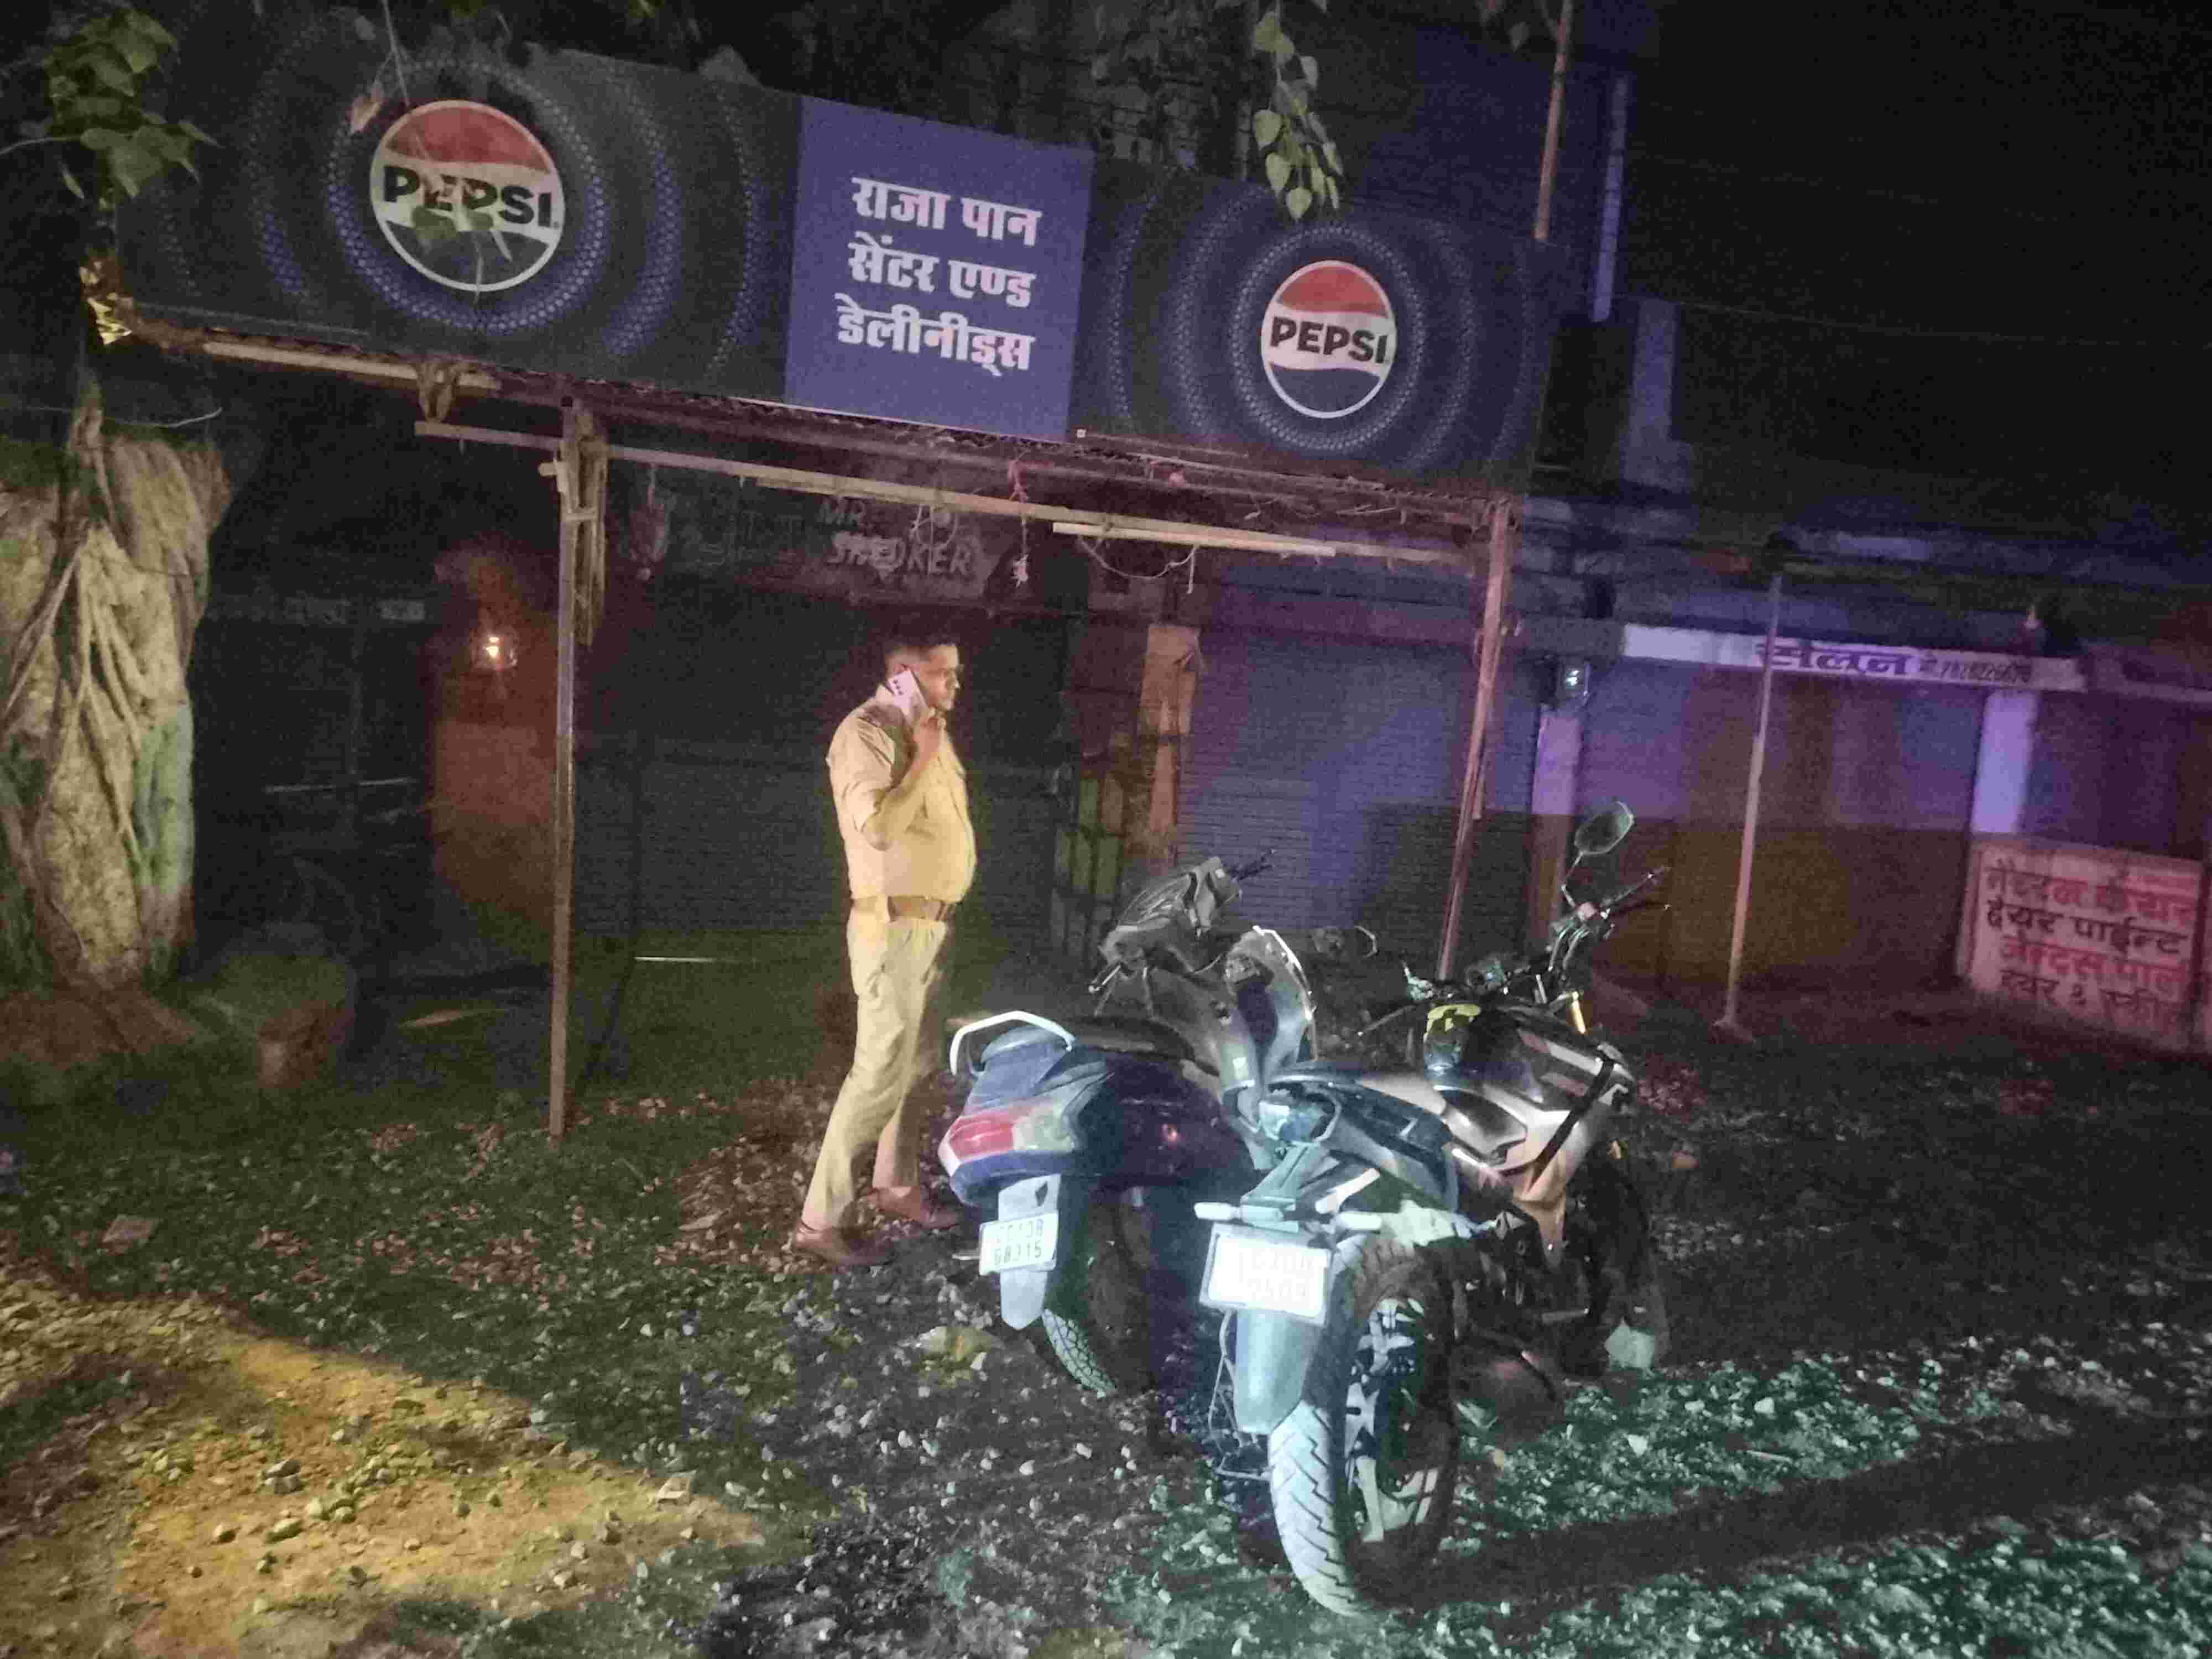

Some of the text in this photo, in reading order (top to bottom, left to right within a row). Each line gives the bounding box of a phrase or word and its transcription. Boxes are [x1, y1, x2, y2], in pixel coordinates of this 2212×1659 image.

[852, 176, 1043, 247] राजा पान
[848, 231, 1037, 308] सेंटर एण्ड
[834, 293, 1036, 377] डेलीनीड्स
[1270, 316, 1388, 363] PEPSI
